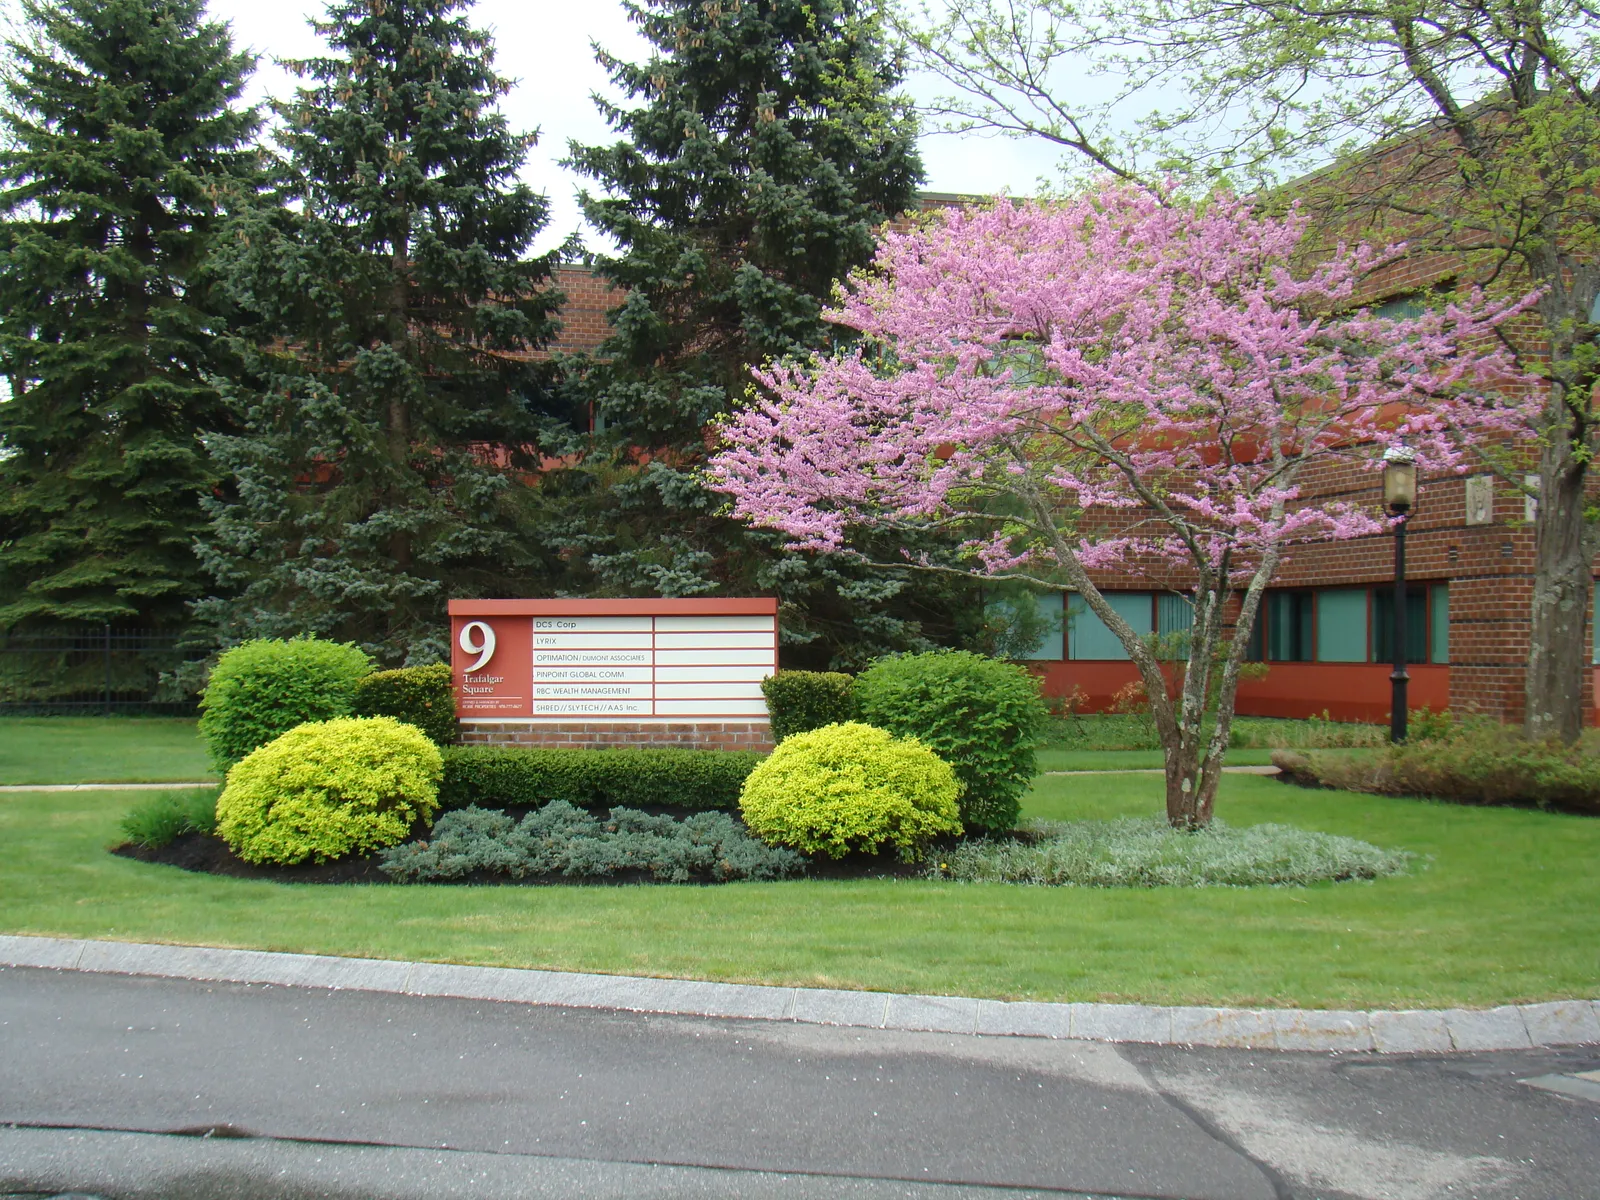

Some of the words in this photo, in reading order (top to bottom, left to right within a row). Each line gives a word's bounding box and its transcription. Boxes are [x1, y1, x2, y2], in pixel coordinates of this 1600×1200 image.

[556, 621, 577, 629] Corp
[459, 621, 496, 673] 9
[462, 674, 504, 684] Trafalgar
[462, 684, 494, 695] Square
